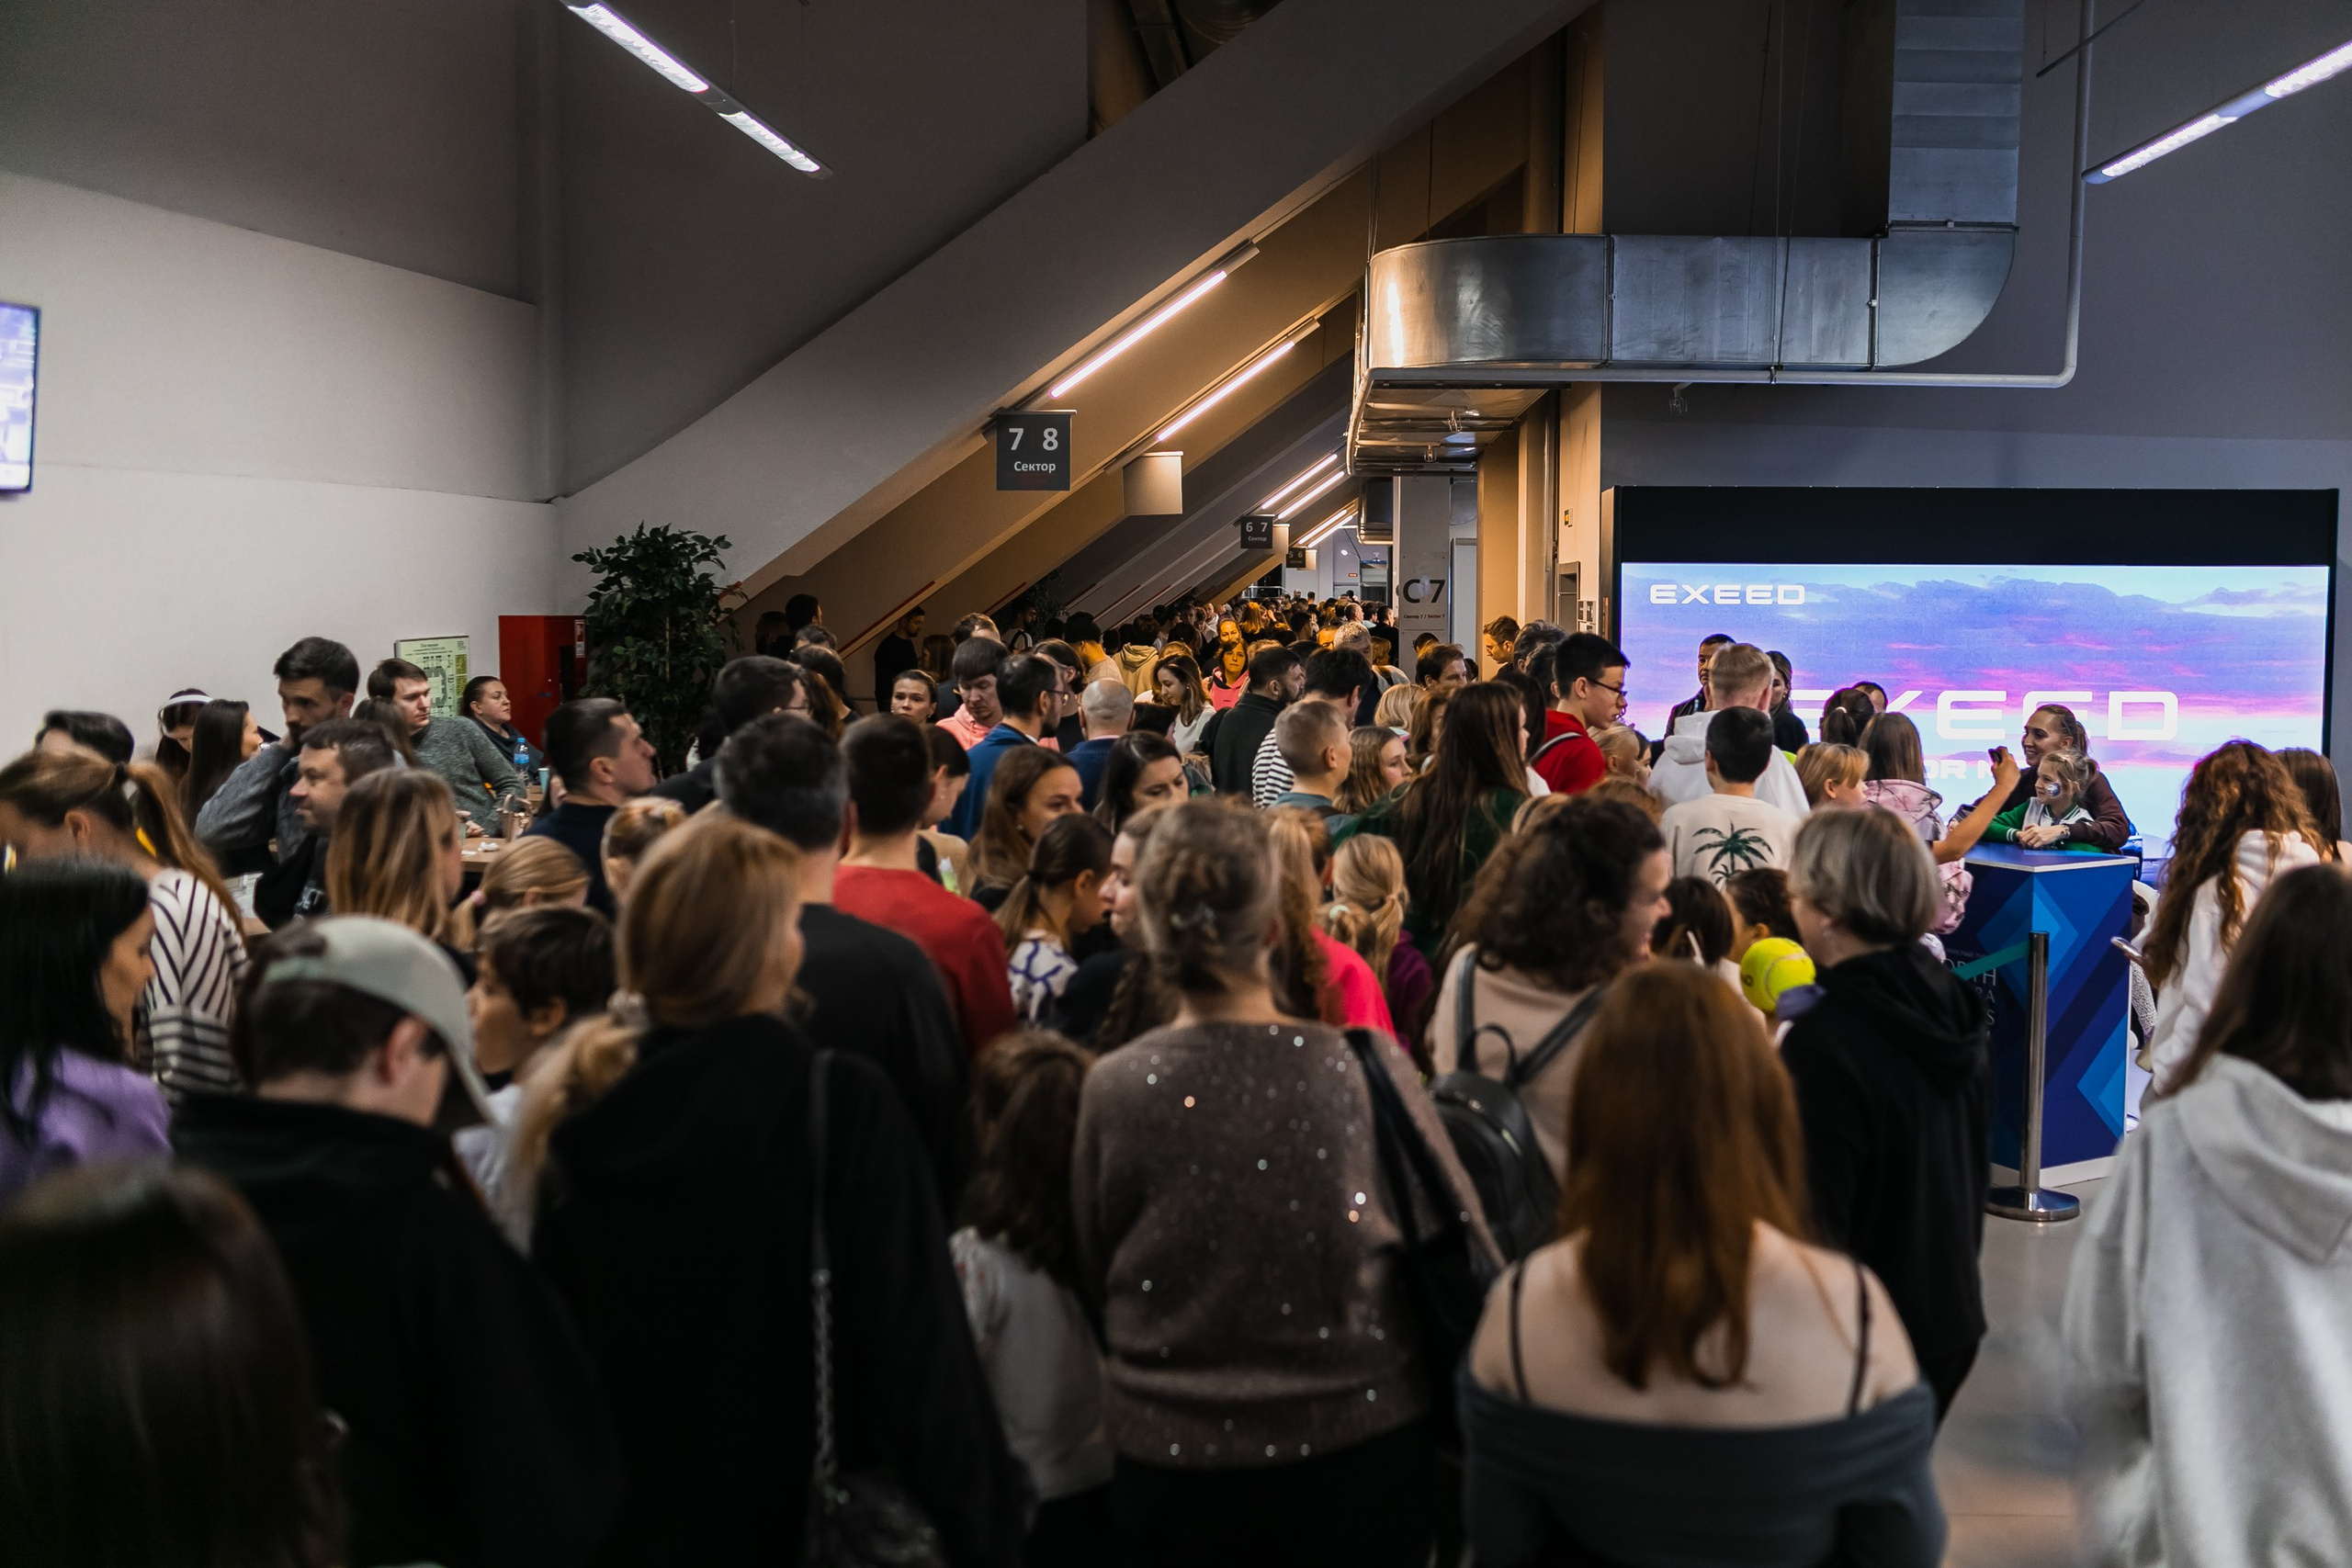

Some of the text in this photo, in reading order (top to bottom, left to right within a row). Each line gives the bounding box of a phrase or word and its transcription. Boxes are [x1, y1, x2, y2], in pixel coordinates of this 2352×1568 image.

[1009, 427, 1058, 451] 7 8
[1013, 461, 1056, 473] Сектор
[1246, 522, 1268, 532] 6 7
[1650, 584, 1805, 604] EXEED
